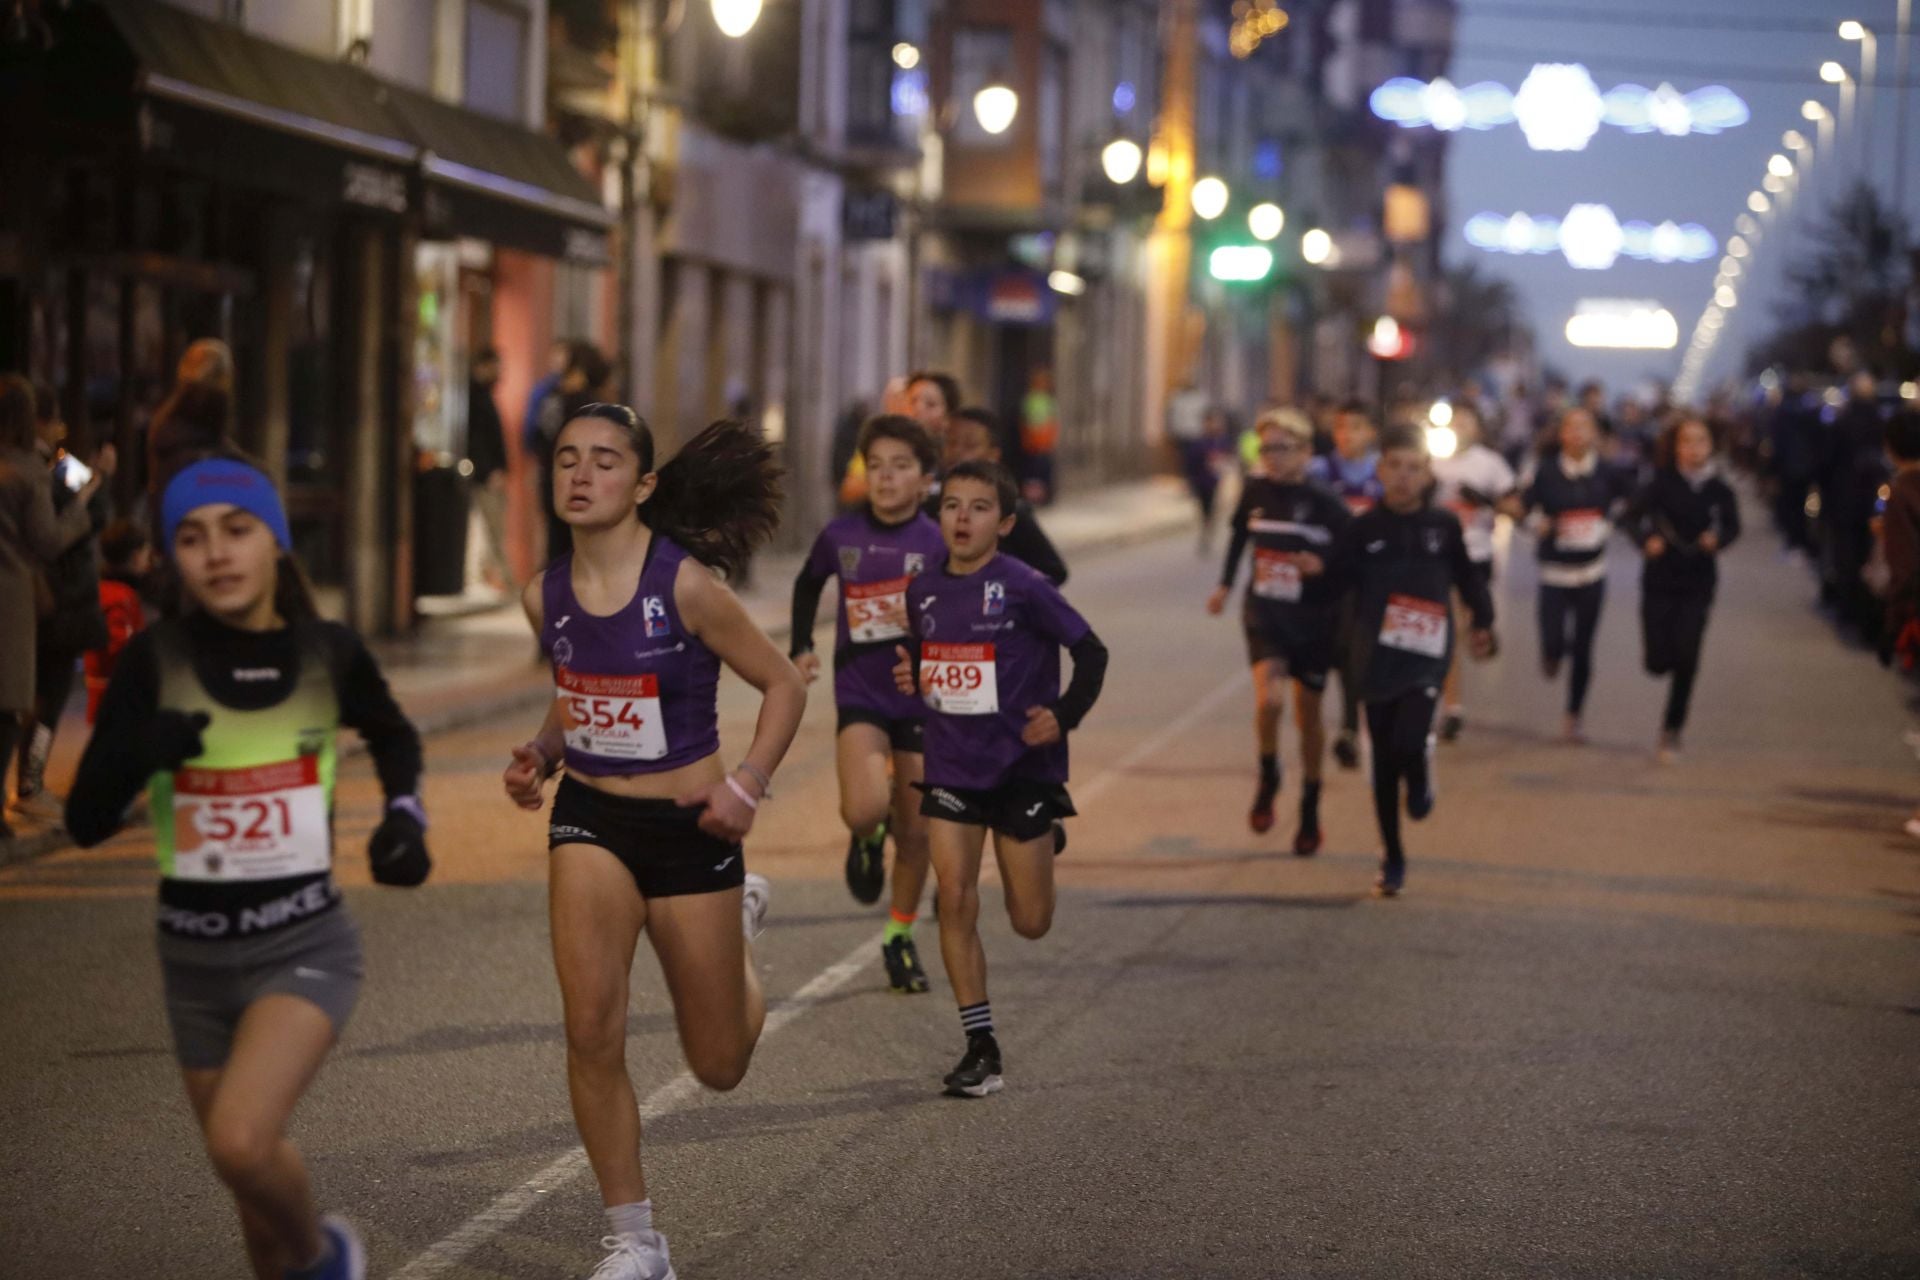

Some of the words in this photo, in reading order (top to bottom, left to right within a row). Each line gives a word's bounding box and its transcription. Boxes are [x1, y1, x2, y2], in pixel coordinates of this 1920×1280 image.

[927, 664, 982, 690] 489
[571, 697, 644, 731] 554
[207, 797, 292, 842] 521
[239, 881, 327, 933] NIKE
